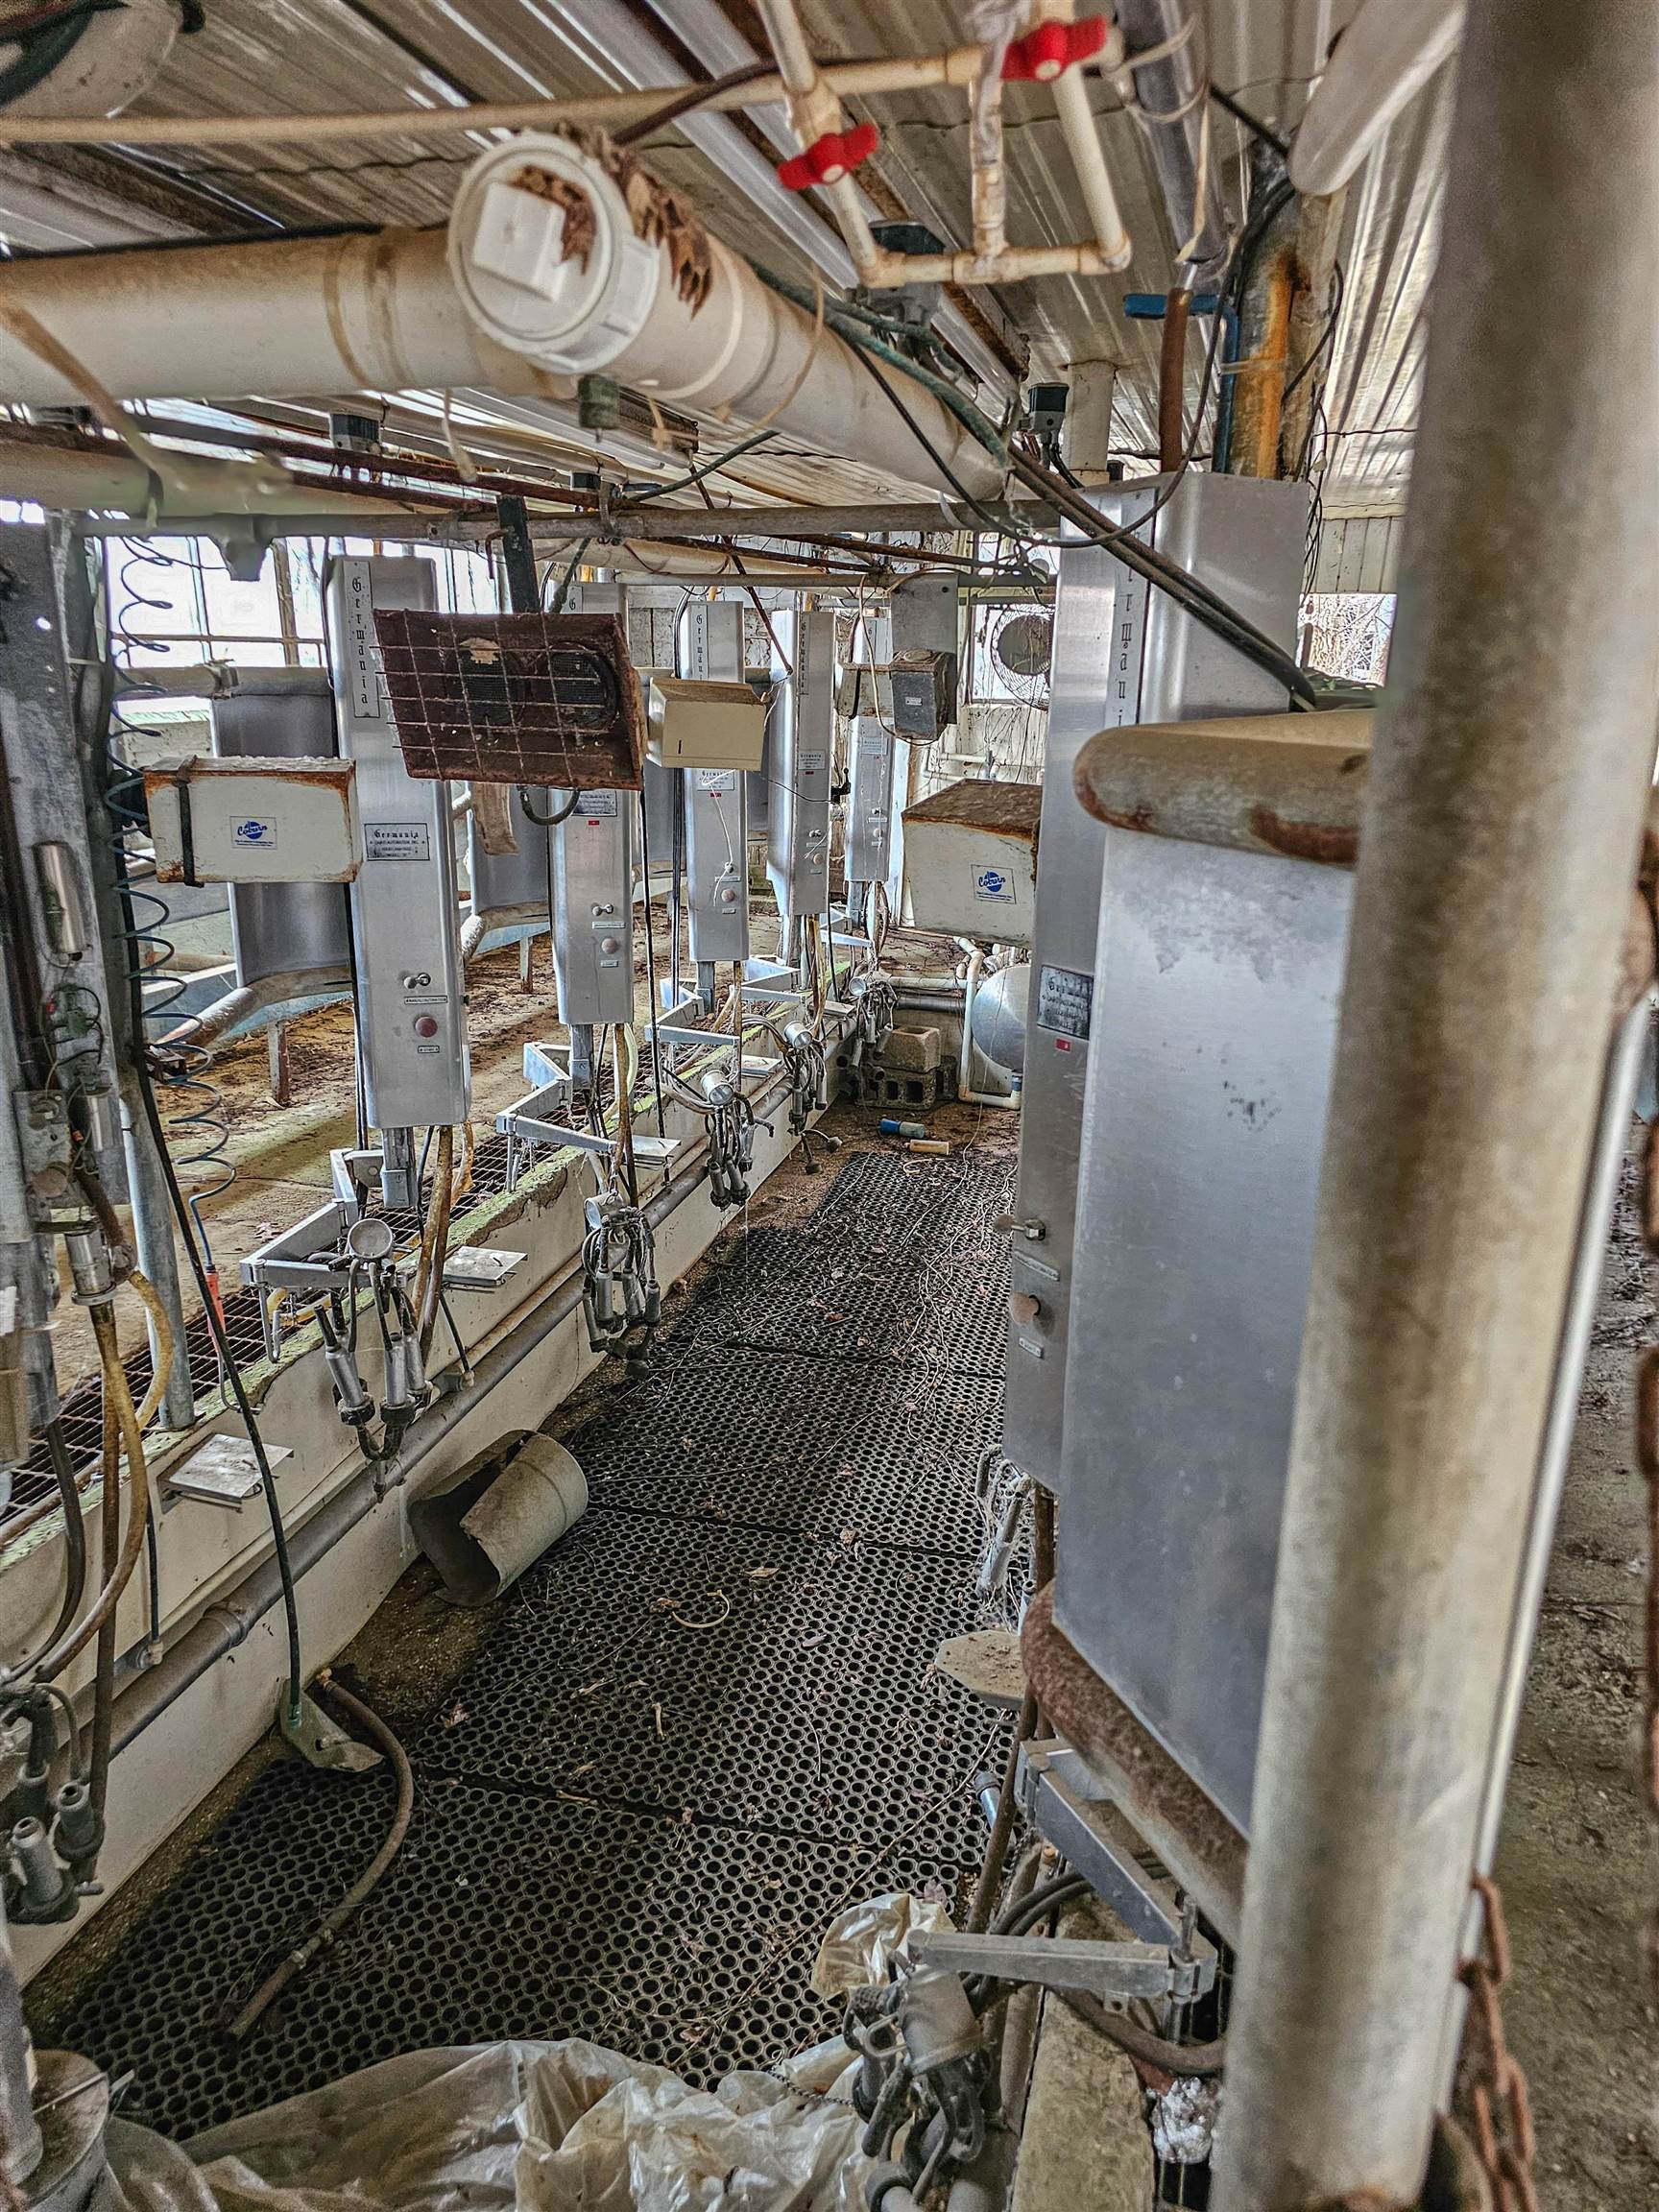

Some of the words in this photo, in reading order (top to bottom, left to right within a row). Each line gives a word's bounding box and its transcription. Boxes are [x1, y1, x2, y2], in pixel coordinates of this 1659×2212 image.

[351, 576, 369, 704] Germania
[237, 821, 268, 836] Coburn
[373, 829, 420, 839] Germania
[977, 871, 1007, 888] Coburn
